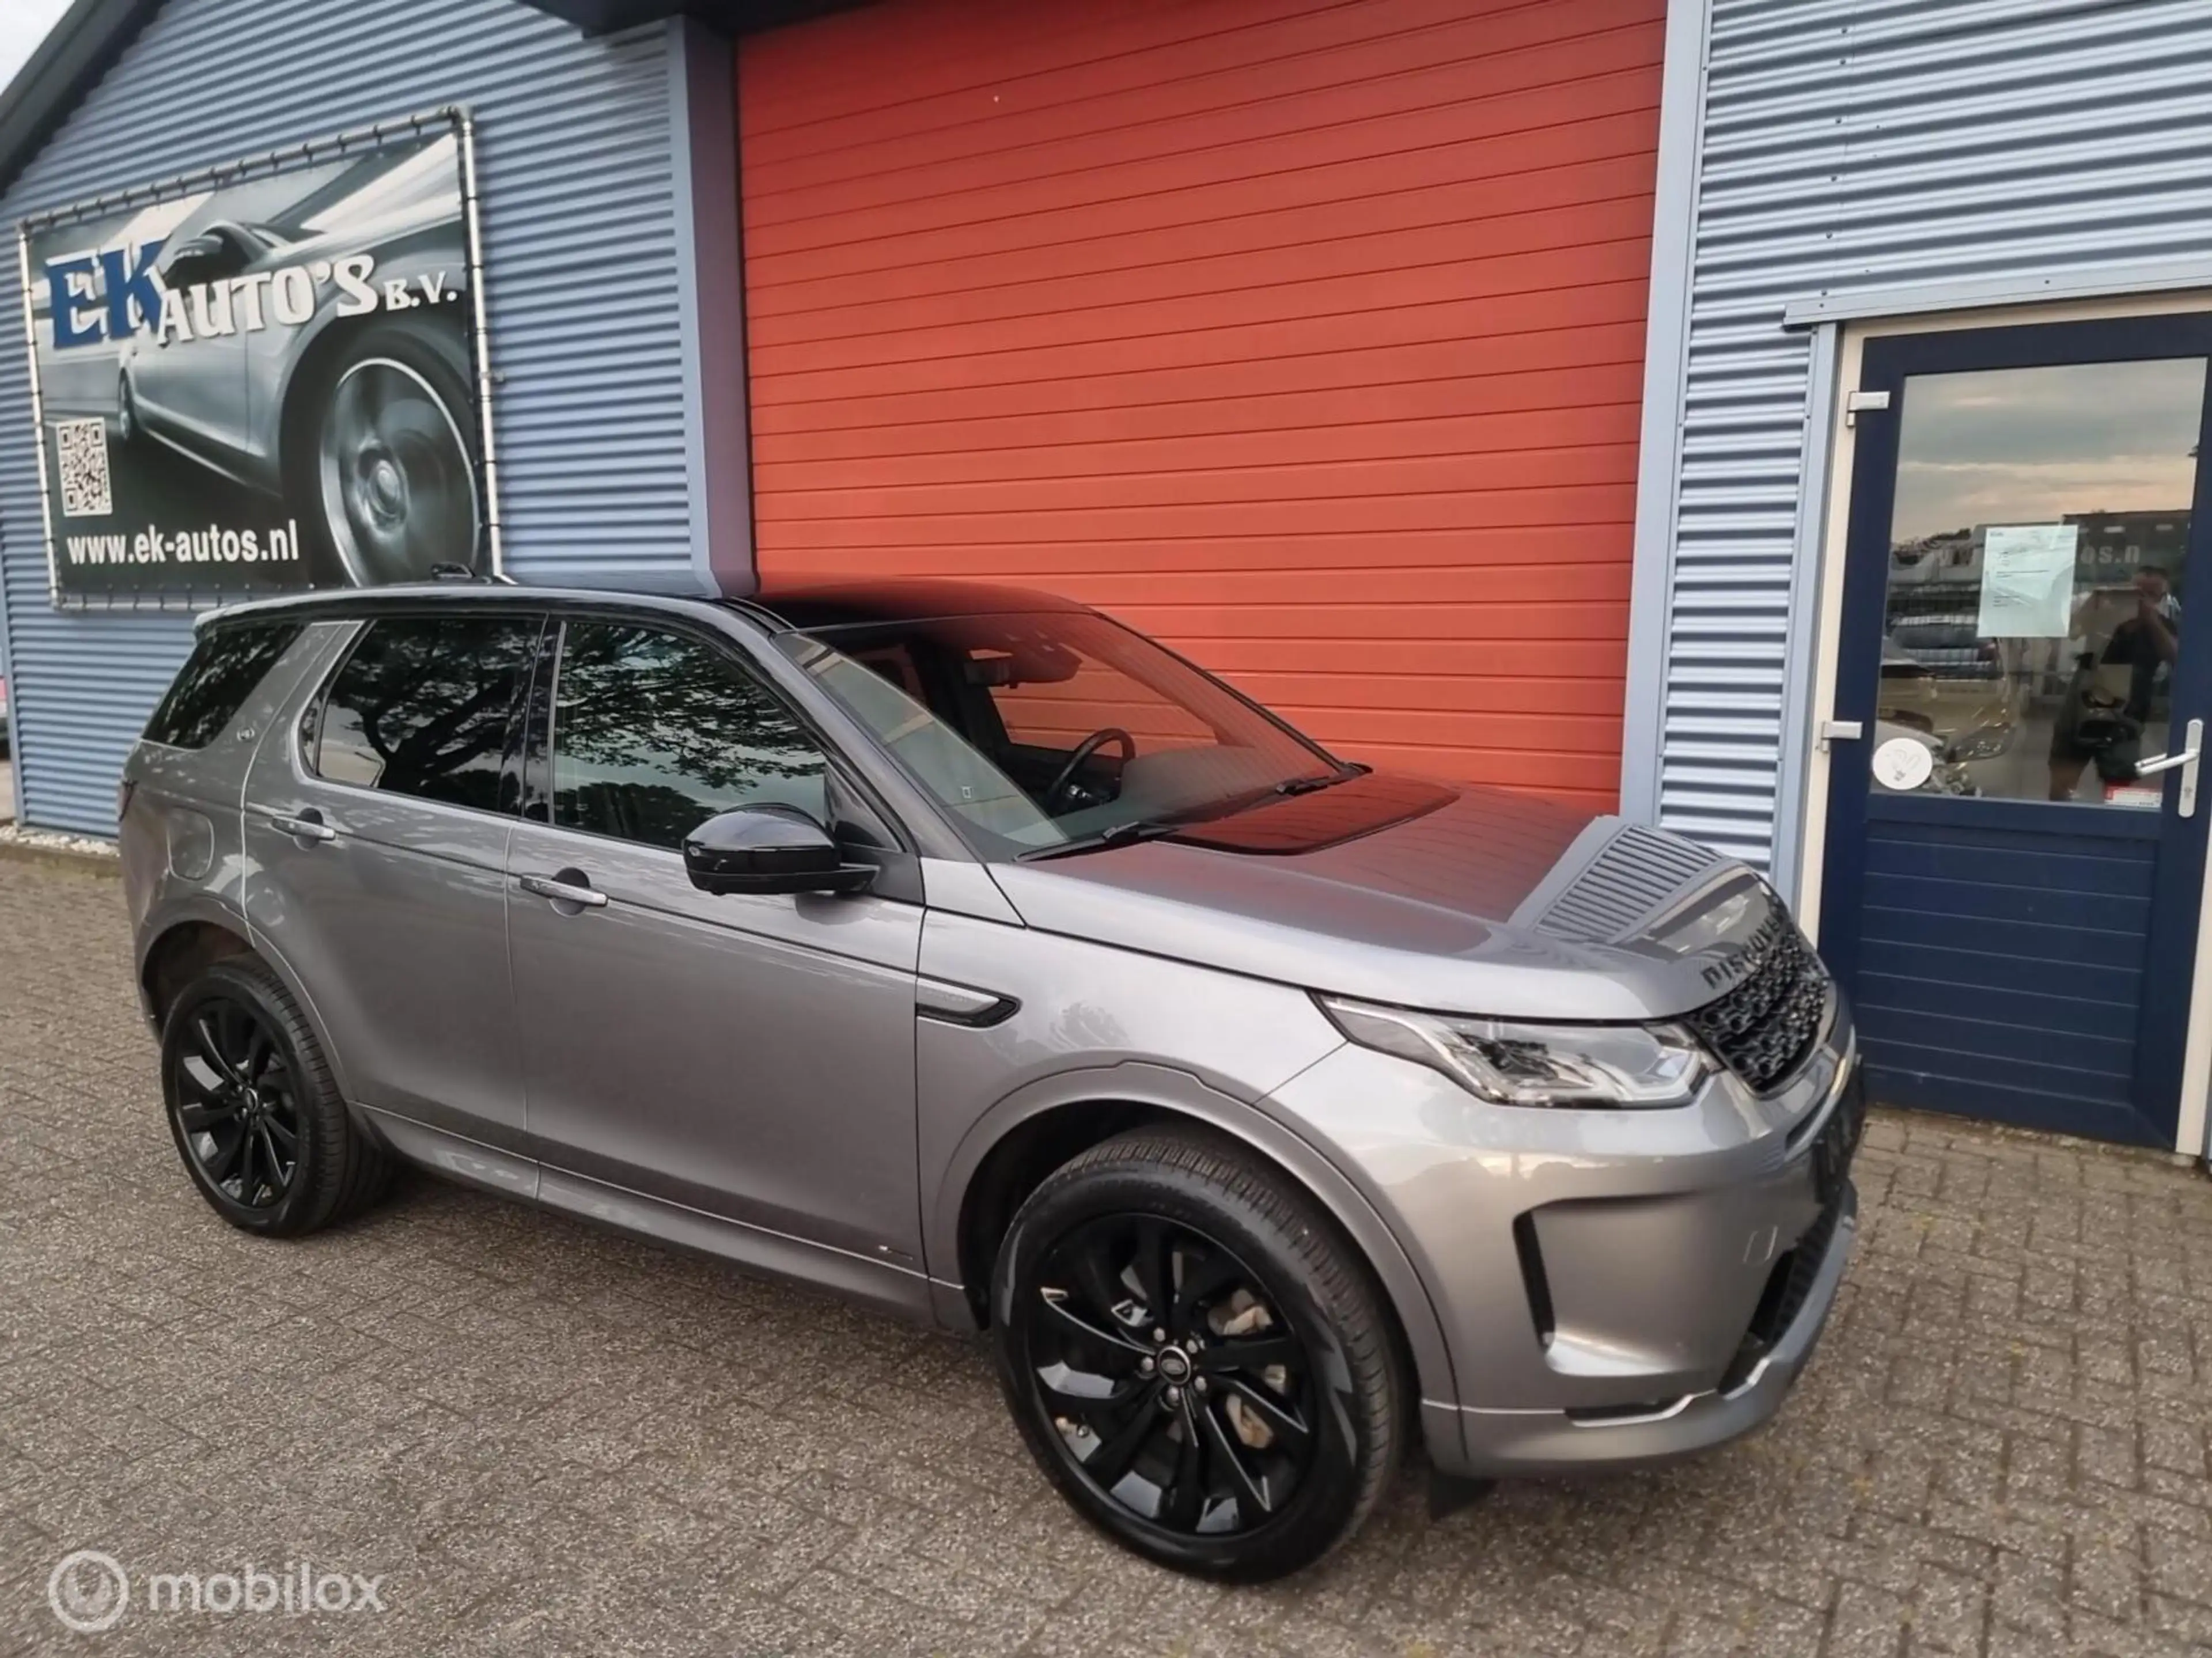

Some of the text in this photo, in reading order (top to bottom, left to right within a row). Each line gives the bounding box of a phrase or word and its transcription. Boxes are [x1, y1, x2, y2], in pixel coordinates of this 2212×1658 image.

[46, 238, 457, 350] EK AUTO'S B.V.
[66, 519, 300, 565] www.ek-autos.nl
